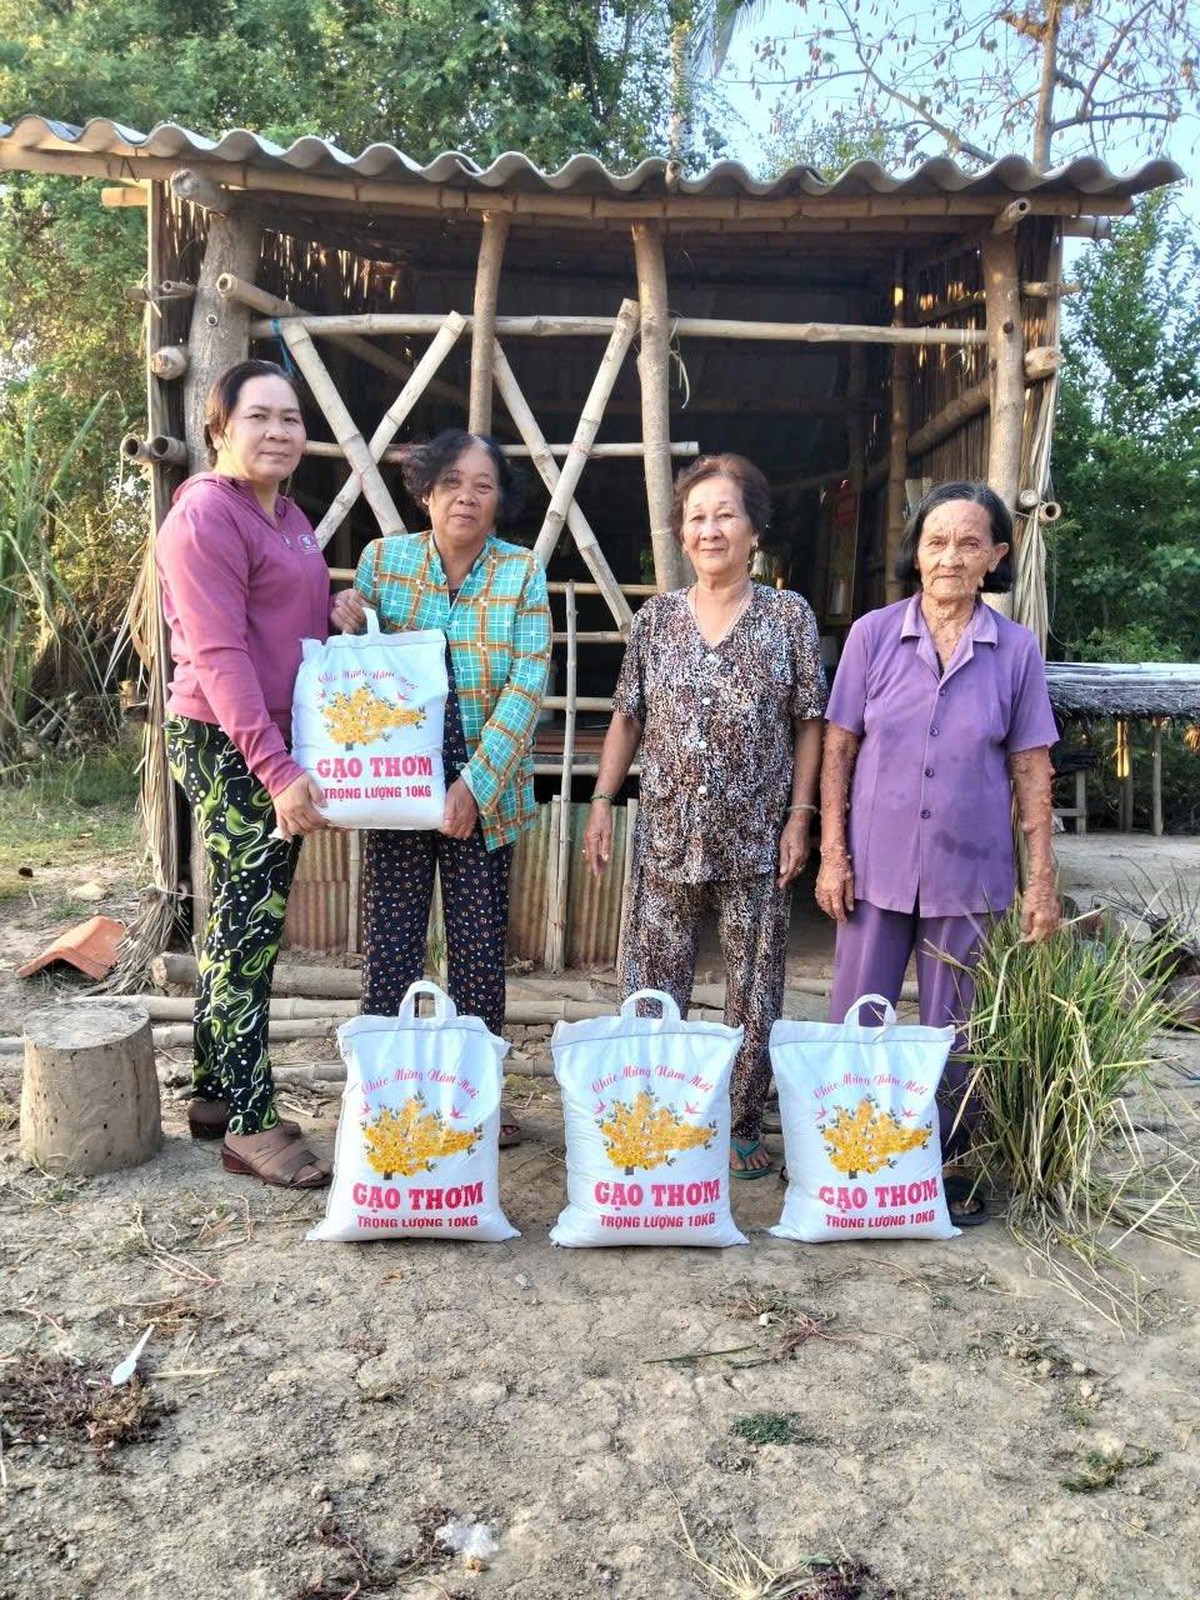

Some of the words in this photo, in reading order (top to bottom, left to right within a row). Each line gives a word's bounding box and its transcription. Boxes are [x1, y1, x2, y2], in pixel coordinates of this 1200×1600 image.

[316, 757, 363, 783] GẠO
[369, 755, 433, 778] THƠM
[323, 787, 361, 802] TRỌNG
[364, 785, 402, 801] LƯỢNG
[405, 785, 432, 798] 10KG
[394, 1067, 423, 1081] Mừng
[427, 1068, 456, 1083] Năm
[591, 1073, 617, 1094] Chúc
[621, 1064, 651, 1079] Mừng
[654, 1065, 686, 1081] Năm
[689, 1075, 714, 1093] Mới
[842, 1071, 870, 1086] Mừng
[353, 1182, 401, 1213] GẠO
[408, 1181, 483, 1210] THƠM
[594, 1181, 644, 1211] GẠO
[651, 1178, 721, 1207] THƠM
[818, 1185, 868, 1213] GẠO
[874, 1176, 938, 1208] THƠM
[357, 1215, 398, 1229] TRỌNG
[402, 1217, 443, 1230] LƯỢNG
[447, 1214, 479, 1227] 10KG
[600, 1214, 640, 1230] TRỌNG
[643, 1214, 683, 1230] LƯỢNG
[688, 1211, 716, 1227] 10KG
[909, 1209, 935, 1225] 10KG
